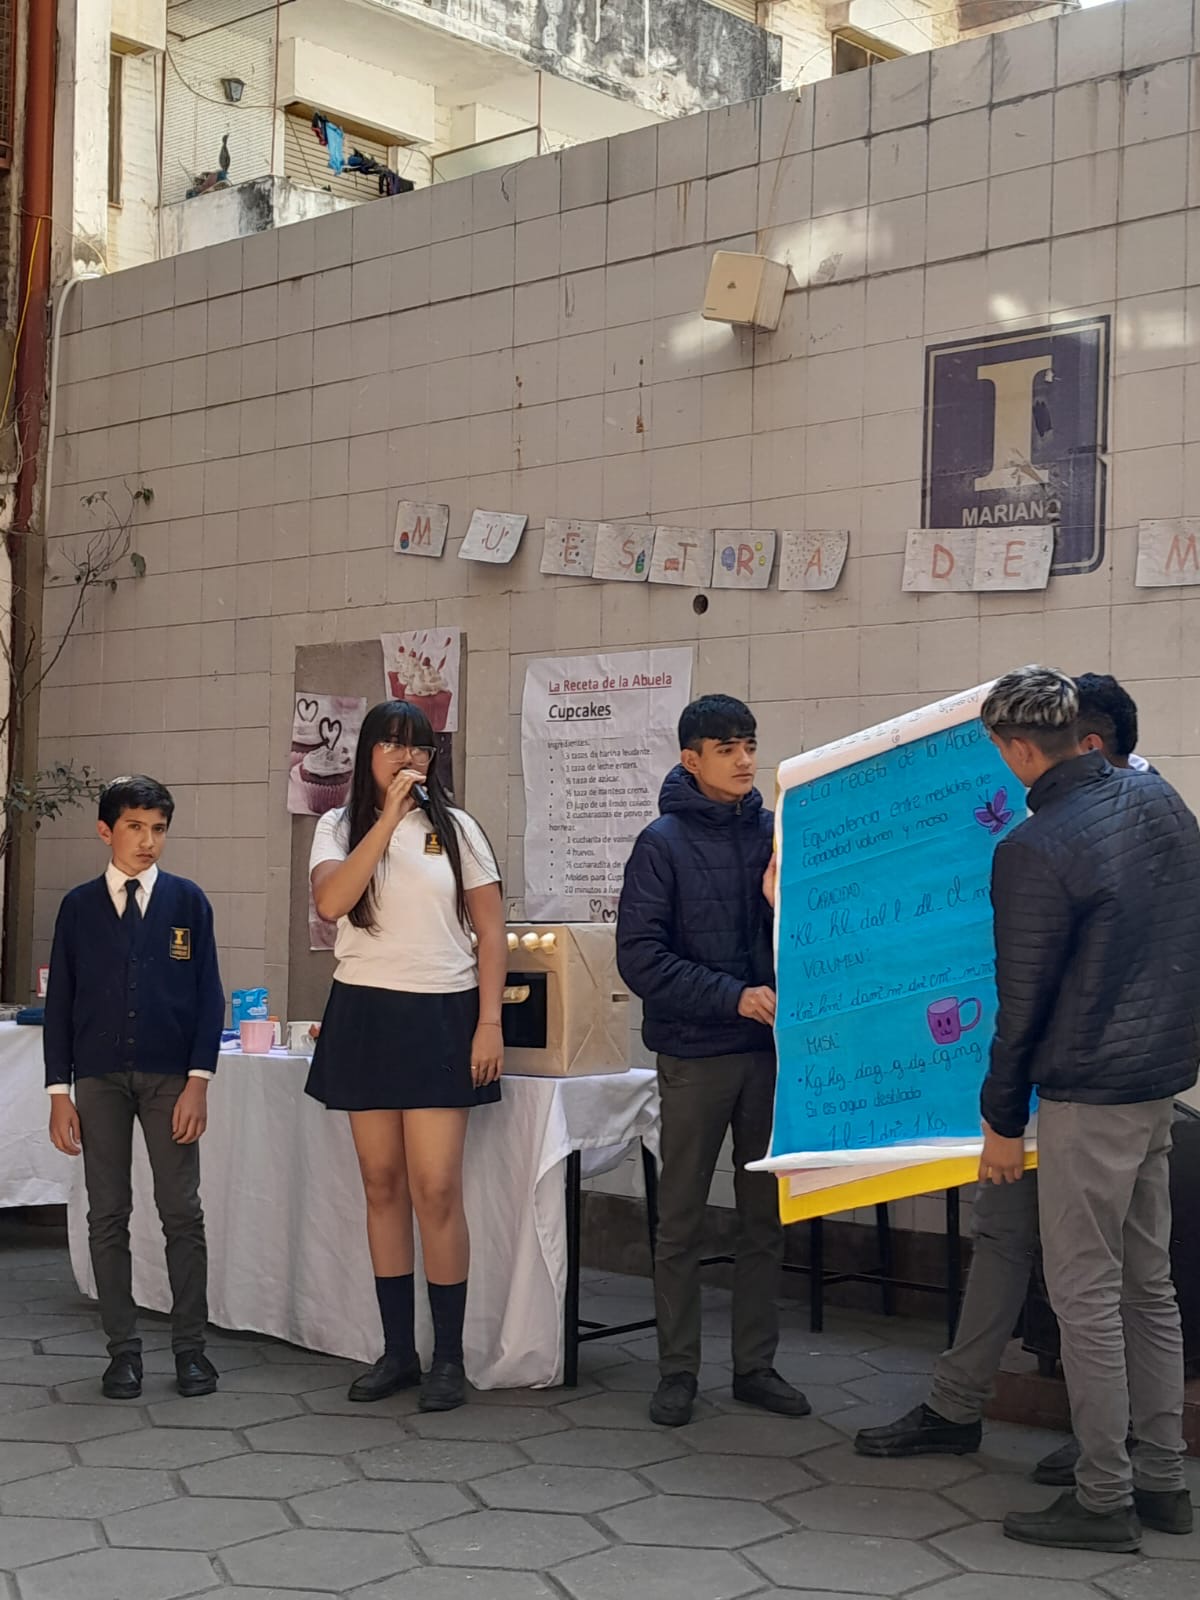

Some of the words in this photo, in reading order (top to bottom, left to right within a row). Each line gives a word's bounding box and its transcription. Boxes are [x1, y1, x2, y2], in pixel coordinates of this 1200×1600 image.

[549, 680, 560, 693] La
[563, 678, 599, 692] Receta
[602, 676, 615, 689] de
[619, 675, 628, 688] la
[632, 672, 672, 687] Abuela
[548, 701, 612, 721] Cupcakes
[809, 782, 831, 802] La
[840, 766, 887, 792] receta
[898, 746, 915, 769] de
[926, 737, 938, 758] la
[976, 773, 992, 789] de
[903, 824, 910, 840] y
[916, 812, 949, 830] masa
[590, 874, 606, 882] para
